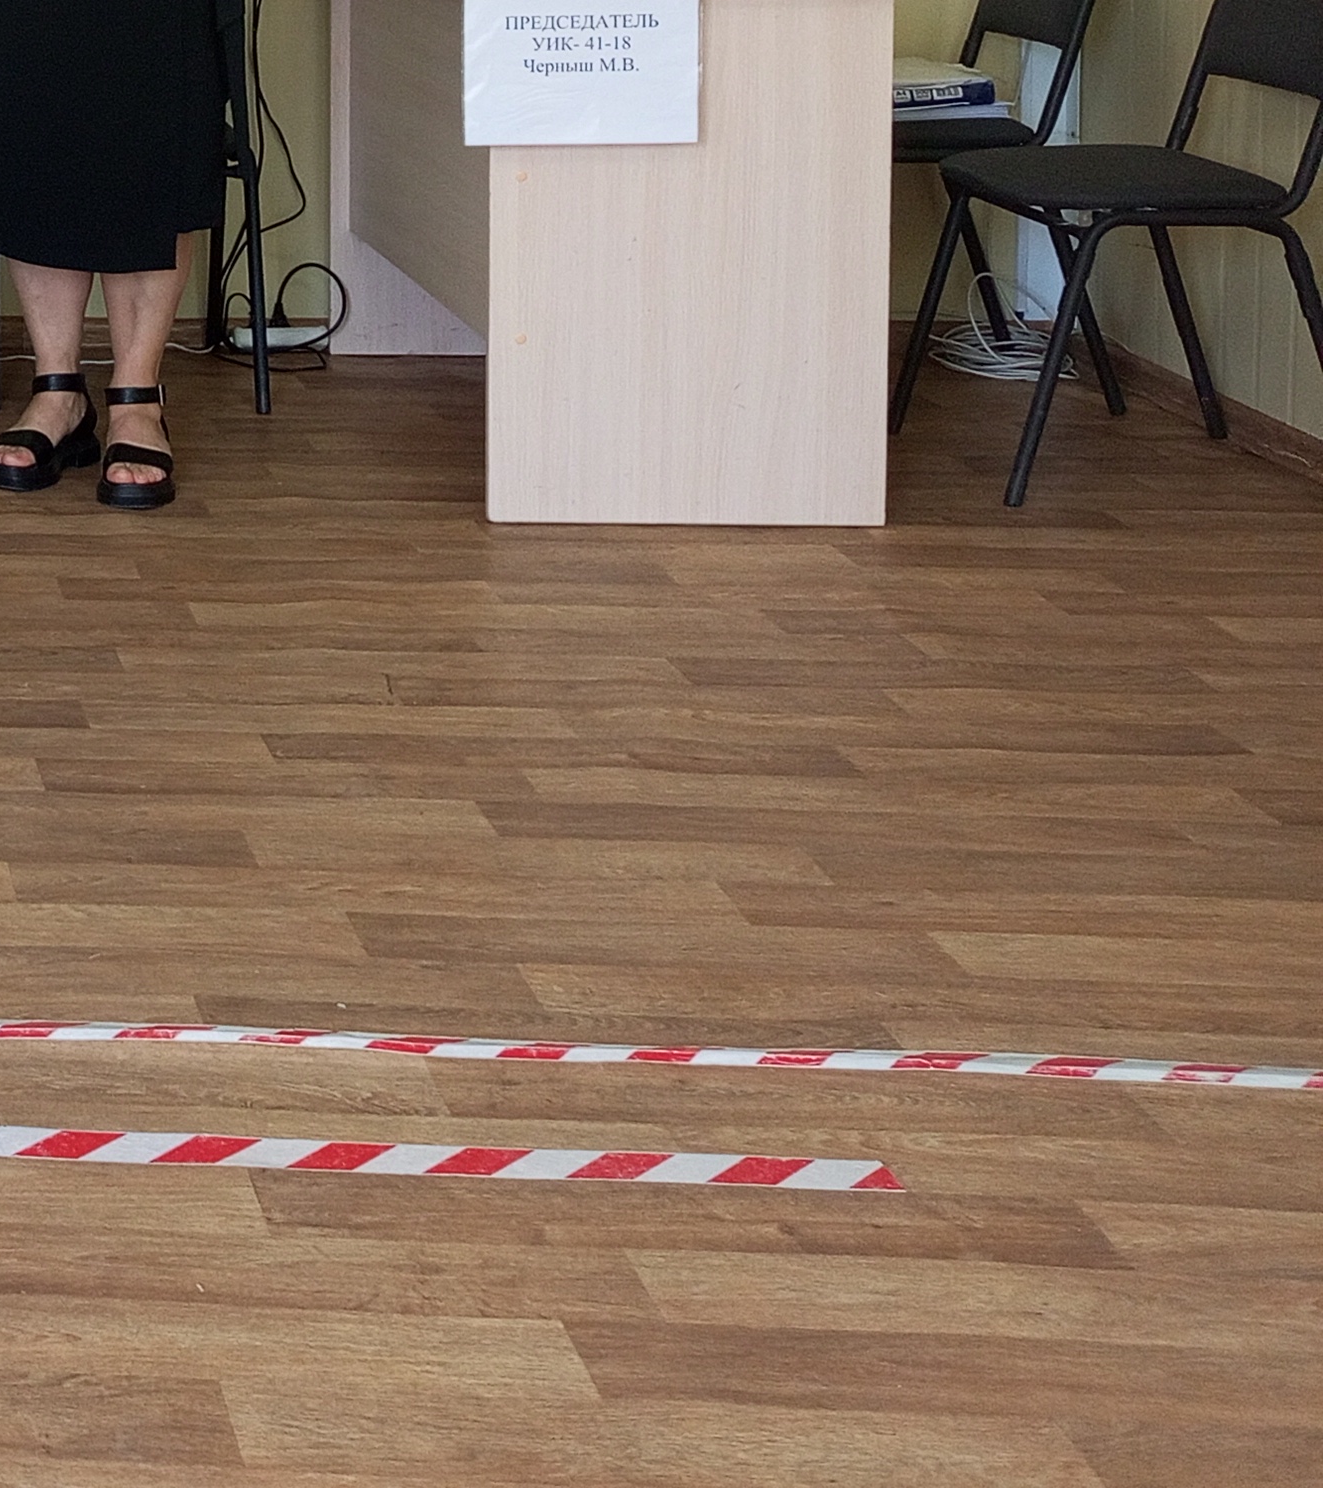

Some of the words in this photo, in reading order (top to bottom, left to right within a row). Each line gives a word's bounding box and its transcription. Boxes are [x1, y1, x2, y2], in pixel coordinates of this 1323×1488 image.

[505, 13, 659, 30] ПРЕДСЕДАТЕЛЬ
[532, 36, 579, 51] УИК-
[585, 35, 632, 50] 41-18
[523, 59, 594, 76] Черныш
[599, 57, 640, 72] М.В.
